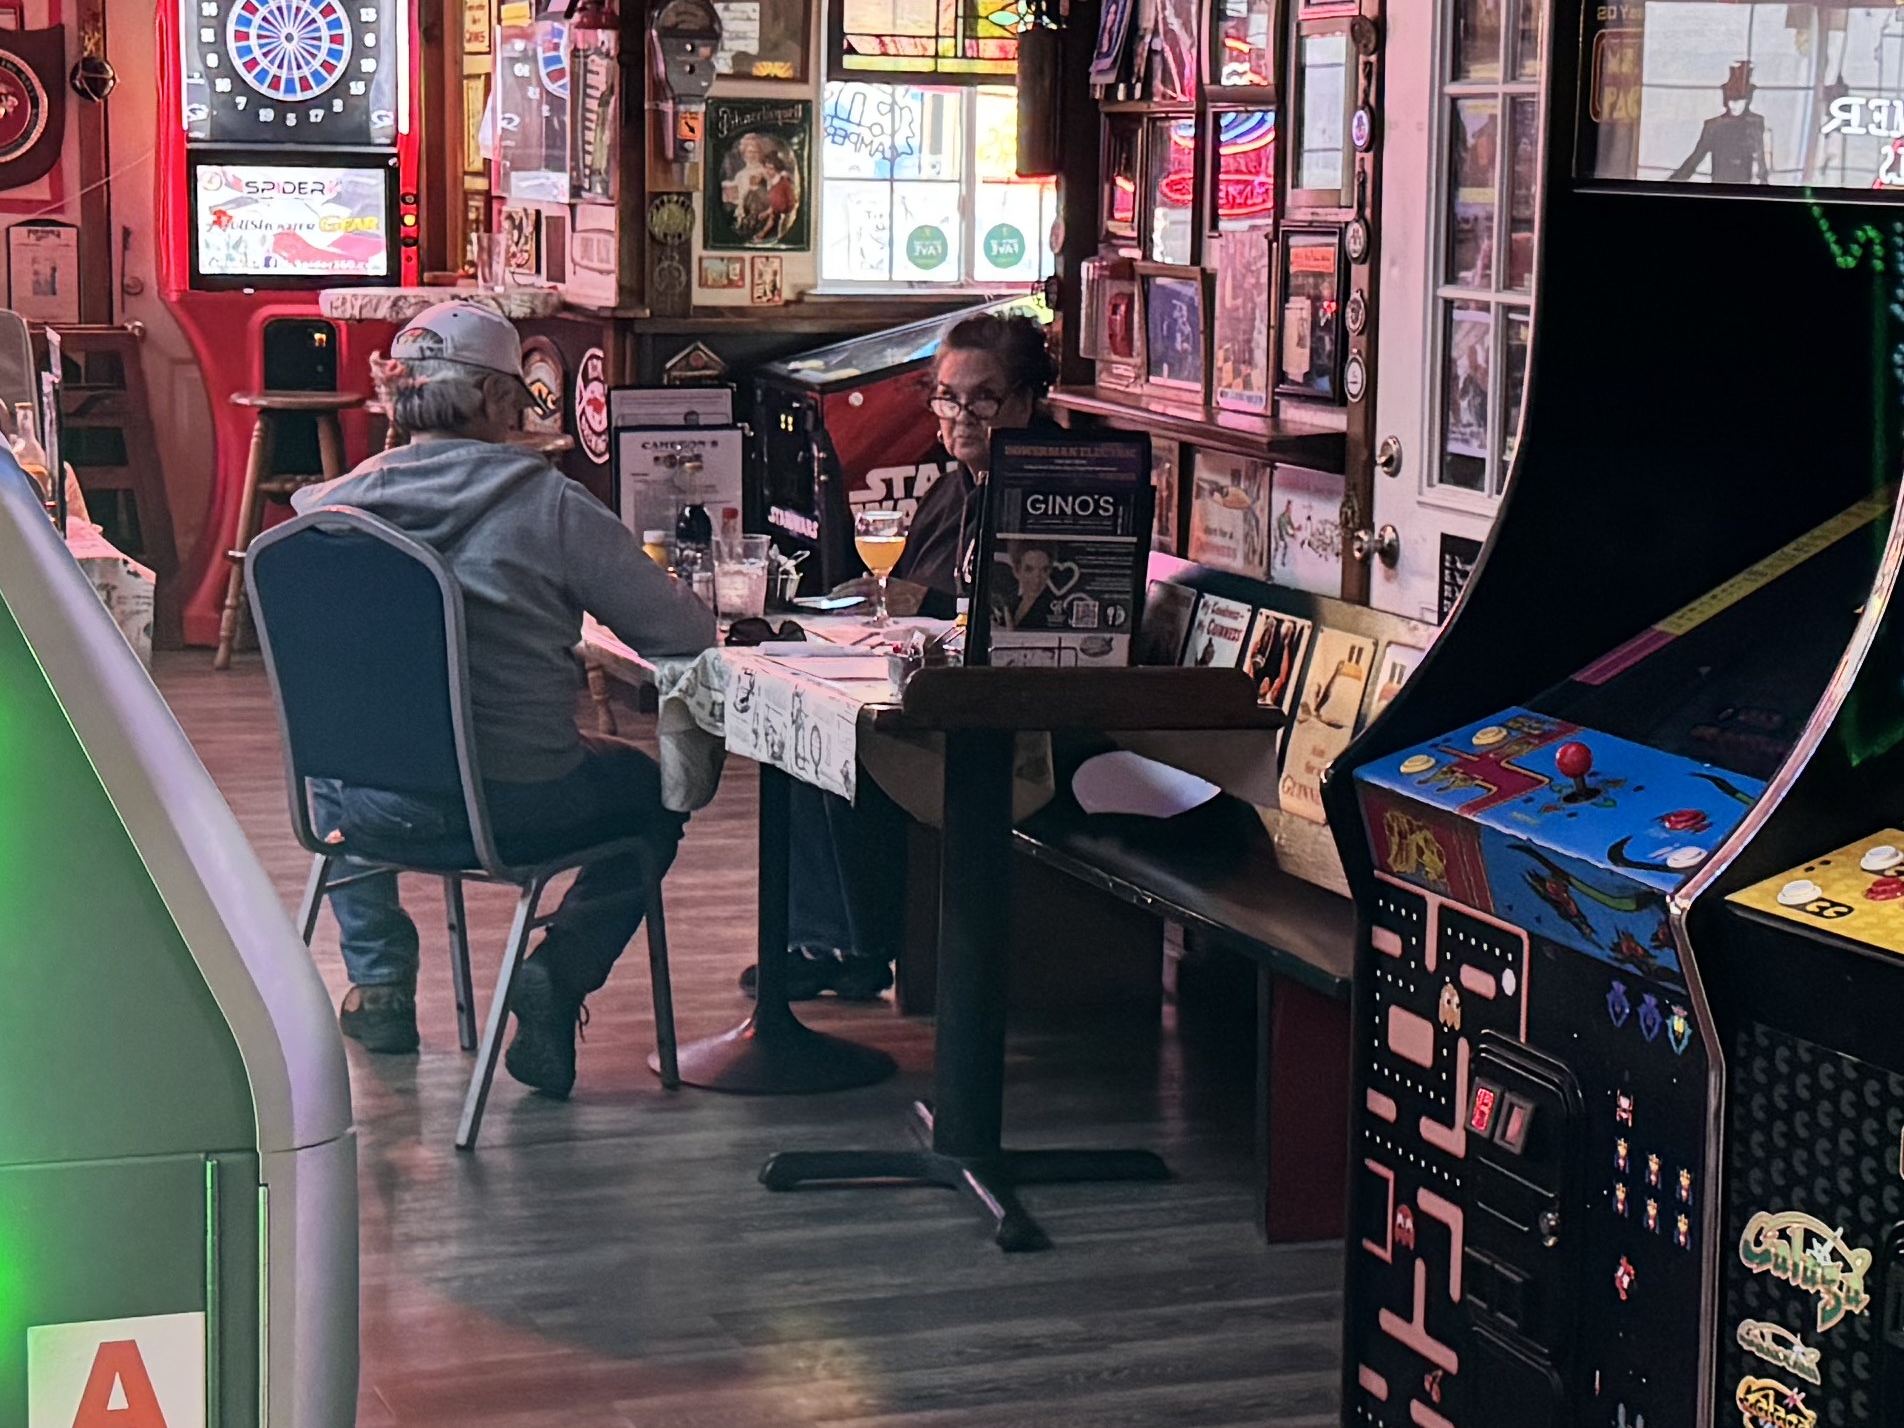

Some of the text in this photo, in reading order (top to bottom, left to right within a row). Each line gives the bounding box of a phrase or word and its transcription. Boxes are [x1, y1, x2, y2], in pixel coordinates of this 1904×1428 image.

[244, 180, 326, 196] SPIDER
[849, 461, 959, 503] STA
[1026, 493, 1115, 517] GINO'S
